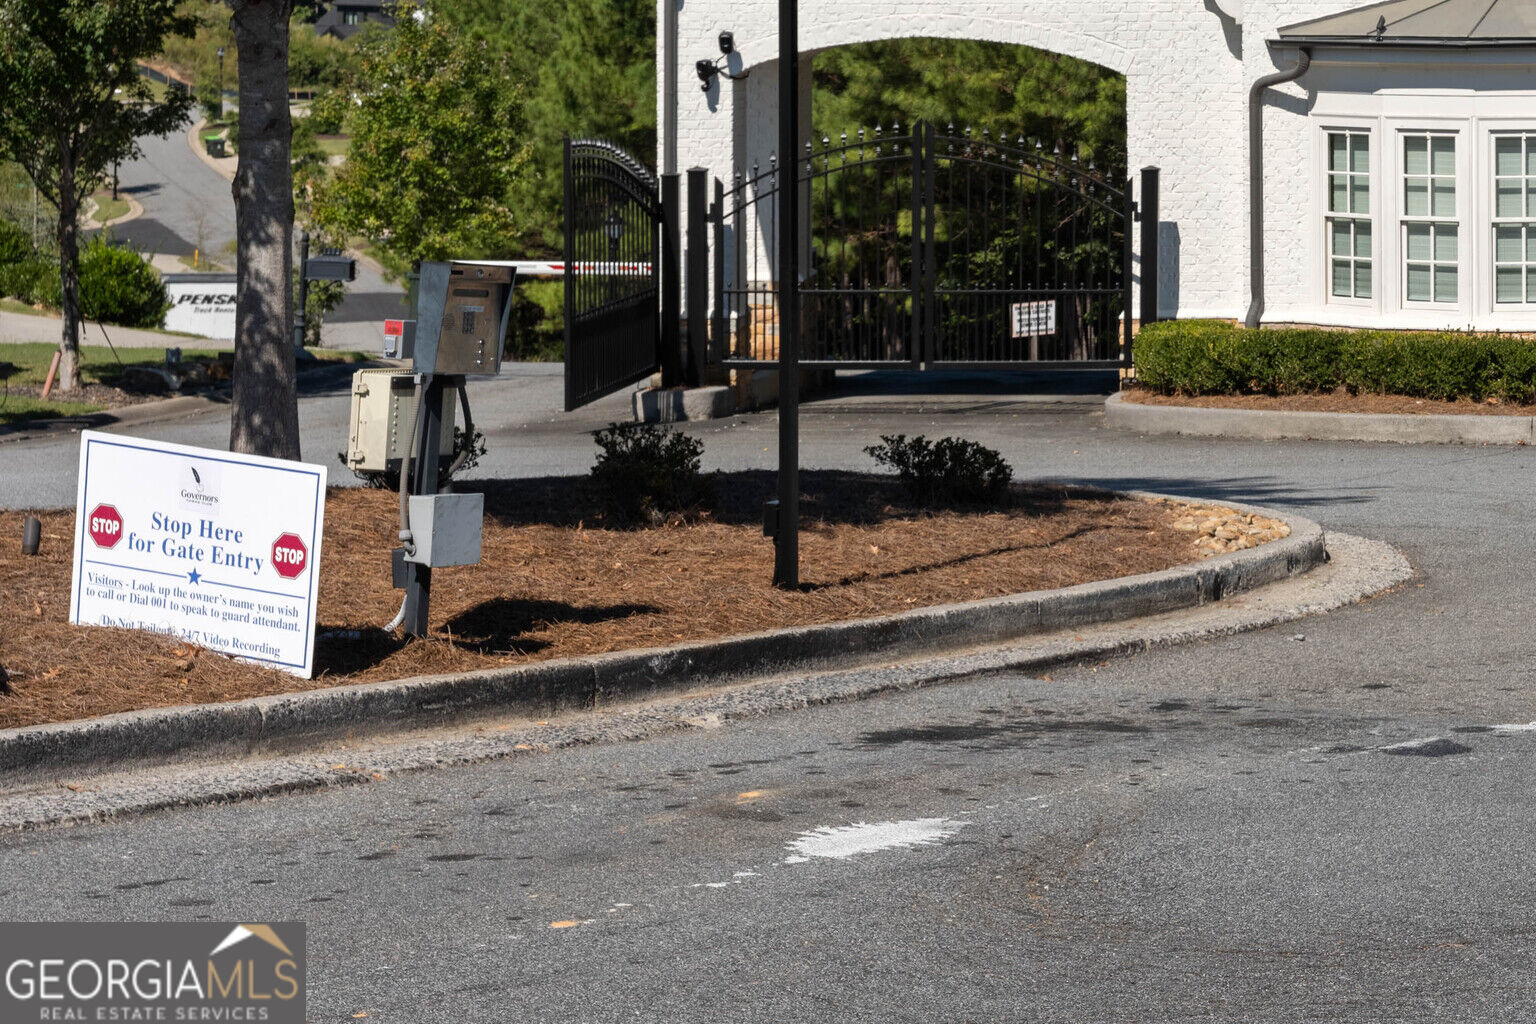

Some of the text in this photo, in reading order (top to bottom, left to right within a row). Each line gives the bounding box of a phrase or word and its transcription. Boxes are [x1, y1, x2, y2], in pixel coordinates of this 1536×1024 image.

[177, 294, 237, 304] PENSK
[180, 489, 219, 503] Governors
[92, 517, 120, 535] STOP
[151, 511, 243, 543] Stop Here
[128, 532, 264, 575] for Gate Entry
[275, 546, 304, 565] STOP
[86, 587, 300, 632] to call or Dial 001 to speak to guard attendant.
[88, 571, 123, 588] Visitors
[132, 579, 155, 593] Look
[158, 586, 171, 597] up
[173, 587, 187, 599] the
[189, 592, 227, 606] owner's
[229, 598, 255, 610] name
[257, 603, 274, 614] you
[278, 605, 299, 618] wish
[102, 615, 115, 626] Do
[119, 617, 134, 629] Not
[181, 628, 200, 643] 24/7
[203, 632, 229, 647] Video
[232, 637, 280, 658] Recording
